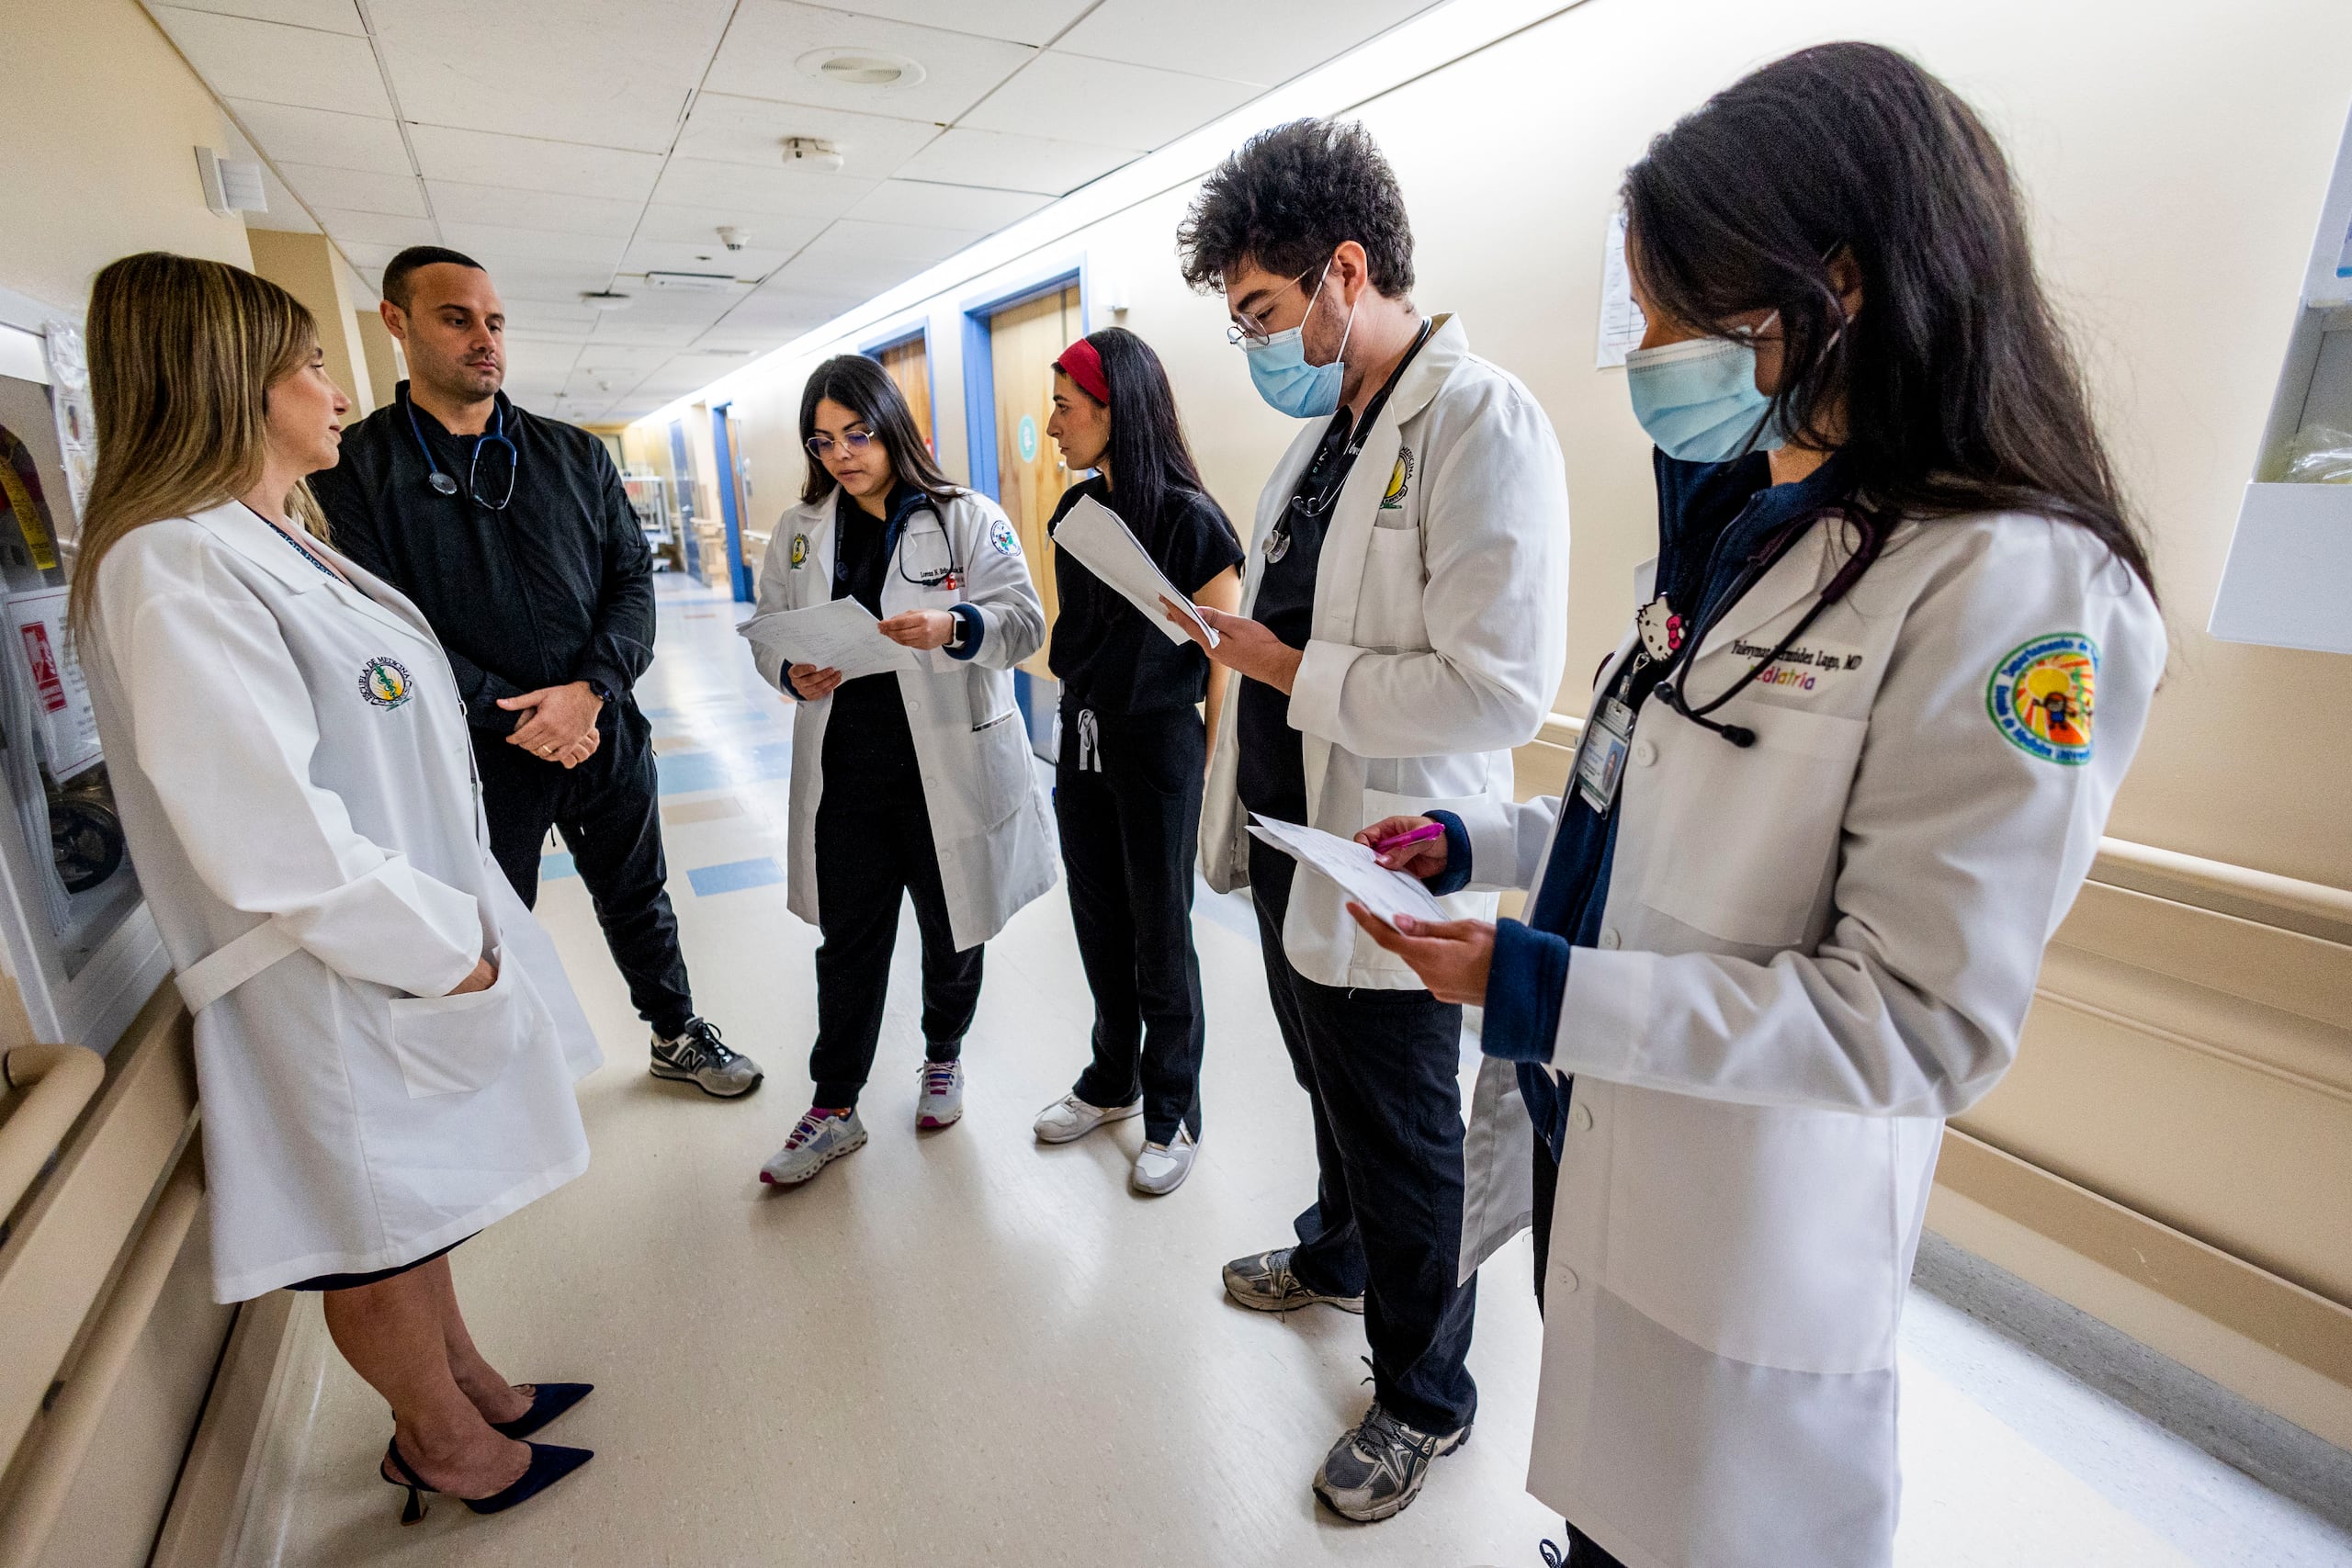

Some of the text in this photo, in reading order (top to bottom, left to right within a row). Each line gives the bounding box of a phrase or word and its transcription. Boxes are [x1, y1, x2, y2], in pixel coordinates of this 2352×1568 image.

[366, 658, 377, 670] DE
[377, 656, 410, 679] MEDICINA
[1843, 653, 1863, 671] MD
